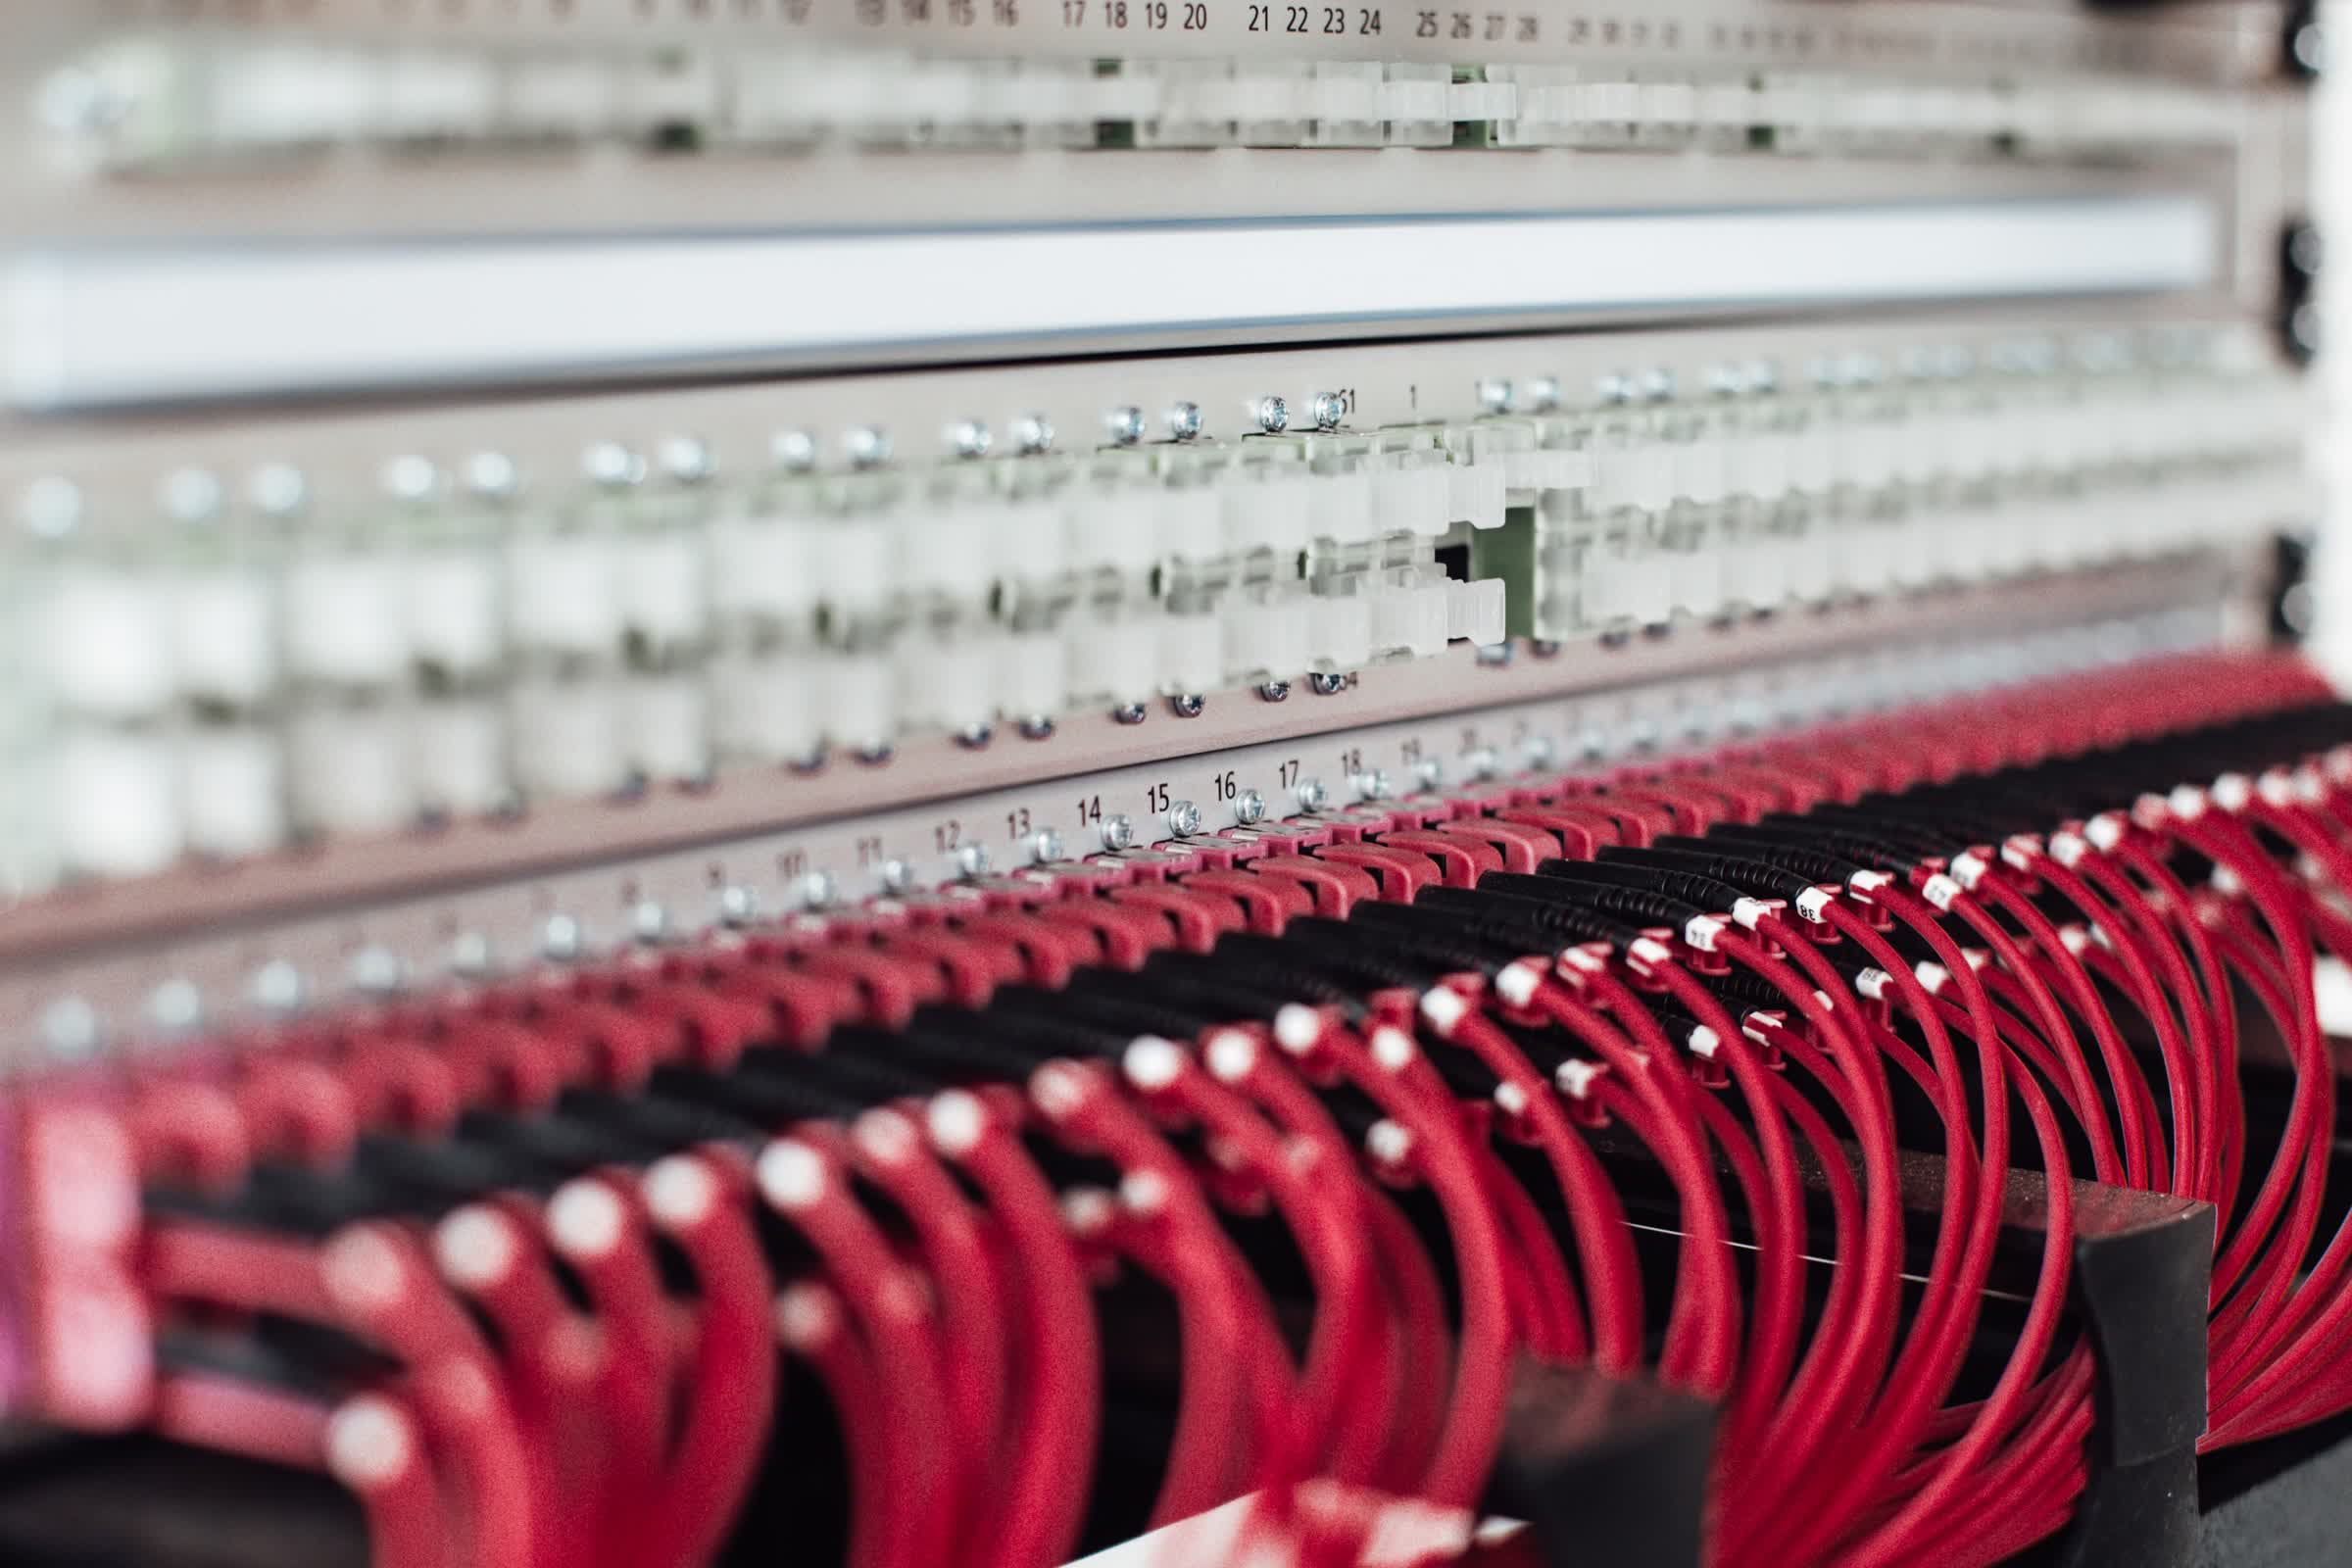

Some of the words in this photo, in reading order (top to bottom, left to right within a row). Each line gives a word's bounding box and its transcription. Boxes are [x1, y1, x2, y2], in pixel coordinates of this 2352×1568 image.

[1063, 0, 1085, 28] 17
[1105, 1, 1127, 28] 18
[1146, 3, 1167, 29] 19
[1183, 4, 1207, 29] 20
[1249, 5, 1269, 31] 21
[1286, 7, 1308, 32] 22
[1323, 8, 1345, 33] 23
[1359, 9, 1381, 35] 24
[1007, 808, 1031, 840] 13
[1078, 796, 1102, 827] 14
[1148, 783, 1170, 813] 15
[1214, 770, 1236, 802] 16
[1279, 760, 1298, 789] 17
[1342, 748, 1362, 777] 18
[1799, 904, 1817, 921] 38
